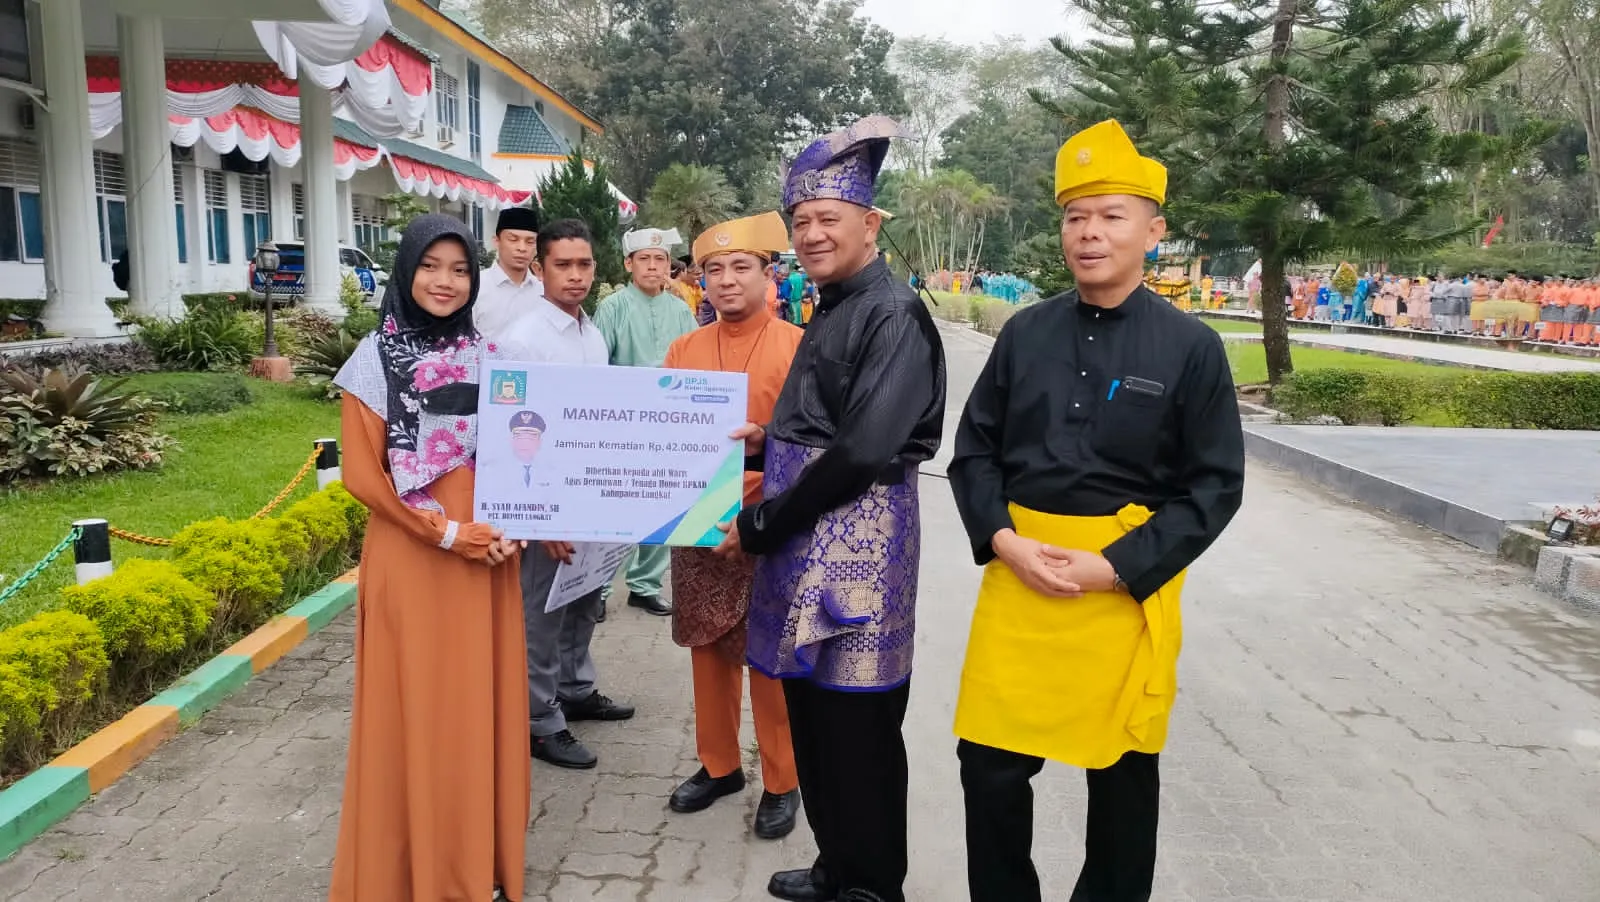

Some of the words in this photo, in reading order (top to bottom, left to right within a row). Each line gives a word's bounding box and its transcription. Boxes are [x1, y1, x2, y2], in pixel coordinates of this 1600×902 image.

[563, 407, 635, 422] MANFAAT
[639, 410, 715, 425] PROGRAM
[554, 439, 596, 449] Jaminan
[598, 440, 645, 451] Kematian
